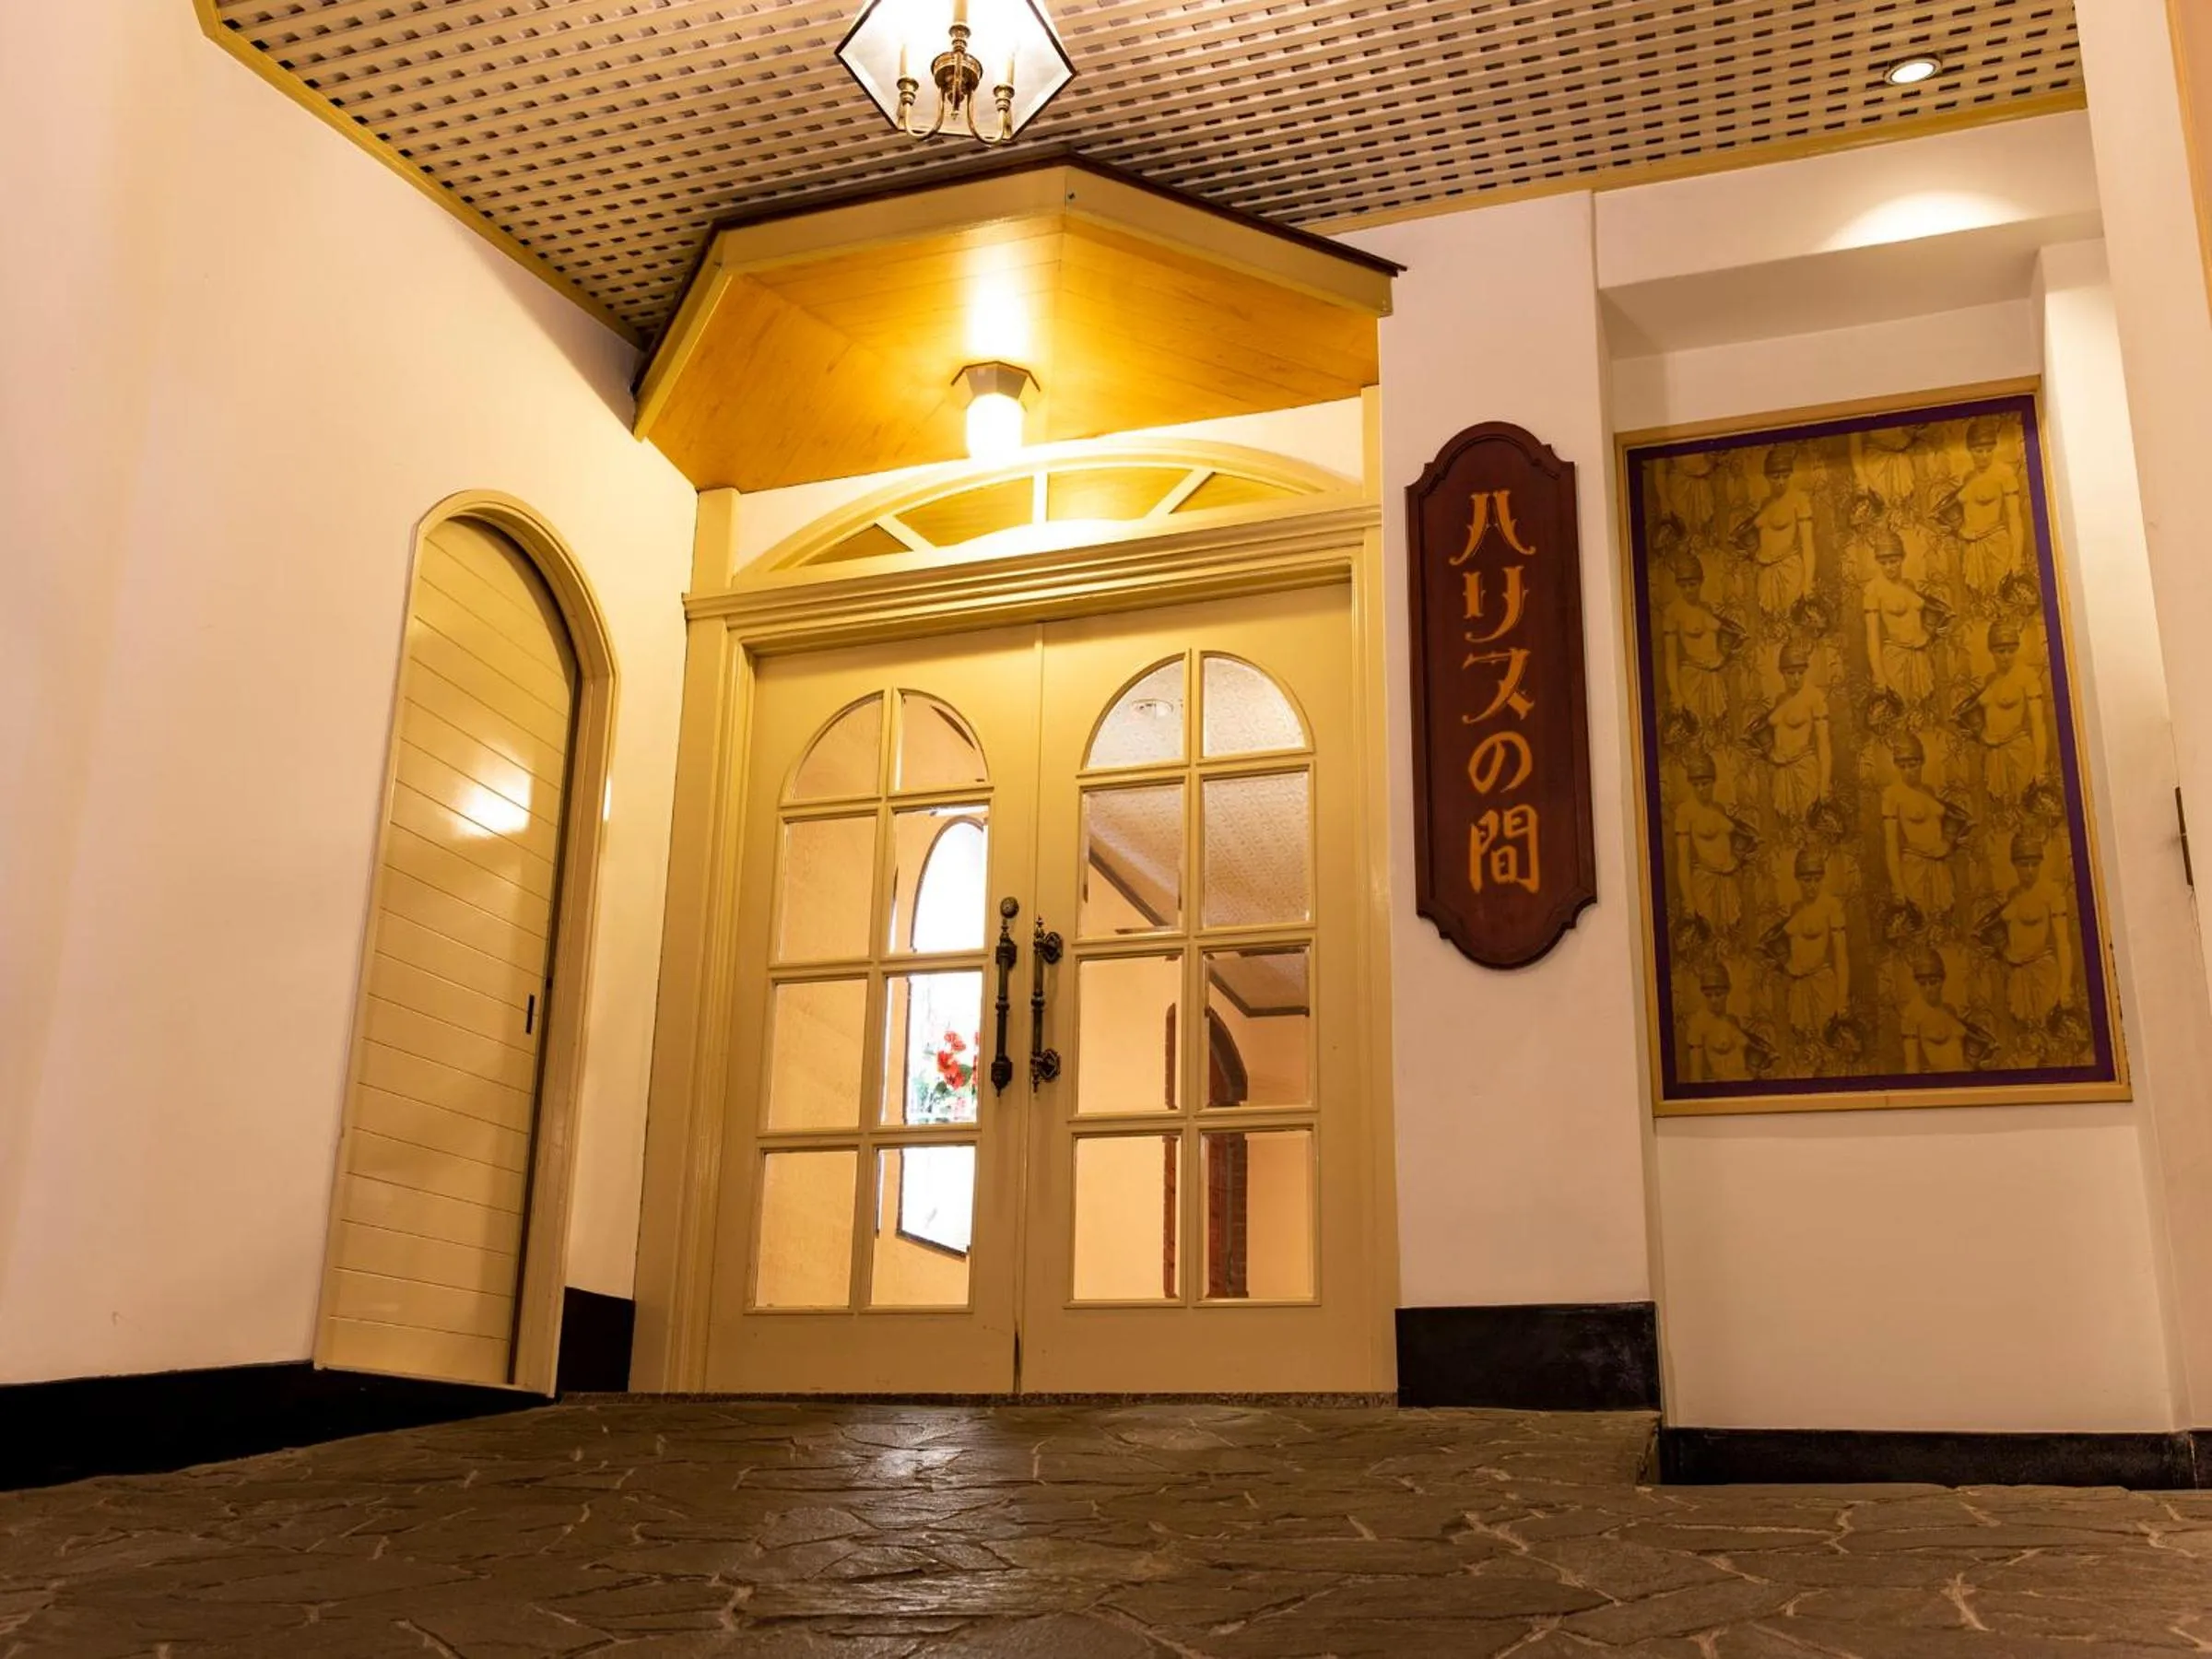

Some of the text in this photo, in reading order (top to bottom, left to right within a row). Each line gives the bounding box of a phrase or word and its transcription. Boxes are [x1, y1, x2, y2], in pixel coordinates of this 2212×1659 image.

[1449, 489, 1539, 894] ハリスの間
